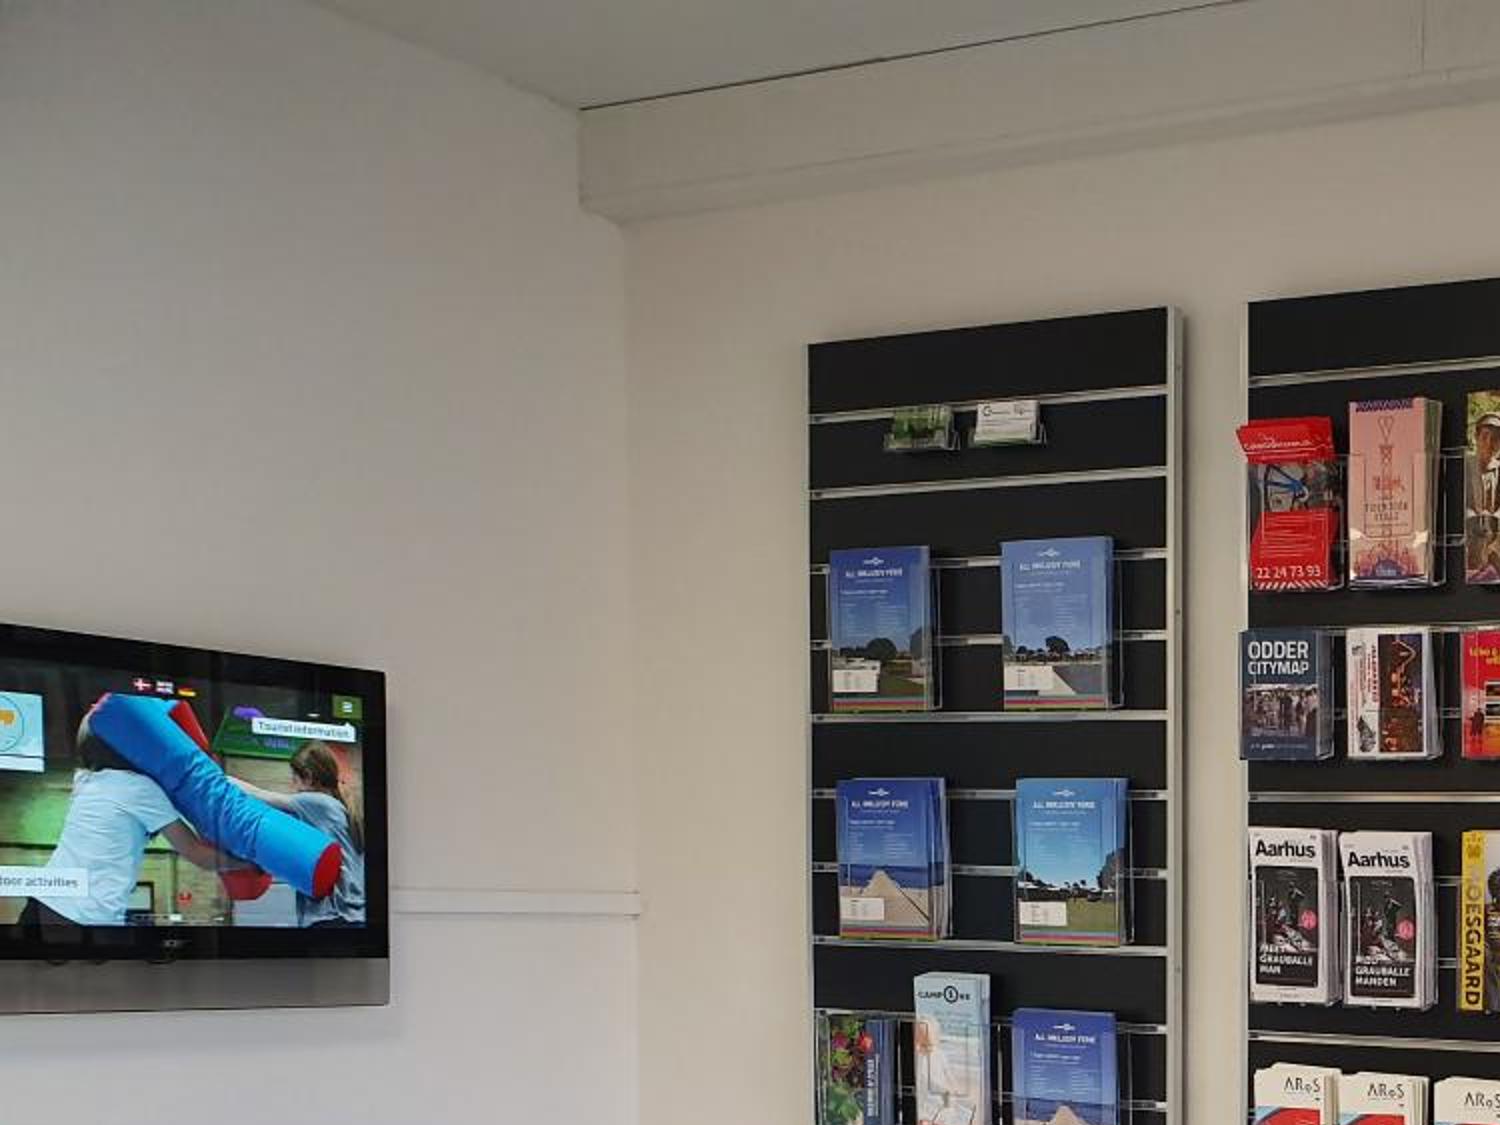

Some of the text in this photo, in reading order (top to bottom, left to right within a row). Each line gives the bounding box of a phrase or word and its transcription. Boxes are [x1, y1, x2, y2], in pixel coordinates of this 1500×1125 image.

[1255, 567, 1271, 579] 22
[1288, 565, 1304, 578] 73
[1305, 564, 1322, 577] 93
[1248, 641, 1309, 659] ODDER
[1247, 661, 1309, 675] CITYMAP
[1255, 840, 1316, 859] Aarhus
[1347, 851, 1411, 869] Aarhus
[0, 875, 79, 888] oor activities
[1259, 953, 1313, 965] GRAUBALLE
[1259, 965, 1282, 975] MAN
[1355, 965, 1411, 977] GRAUBALLE
[1355, 976, 1398, 988] MANDEN
